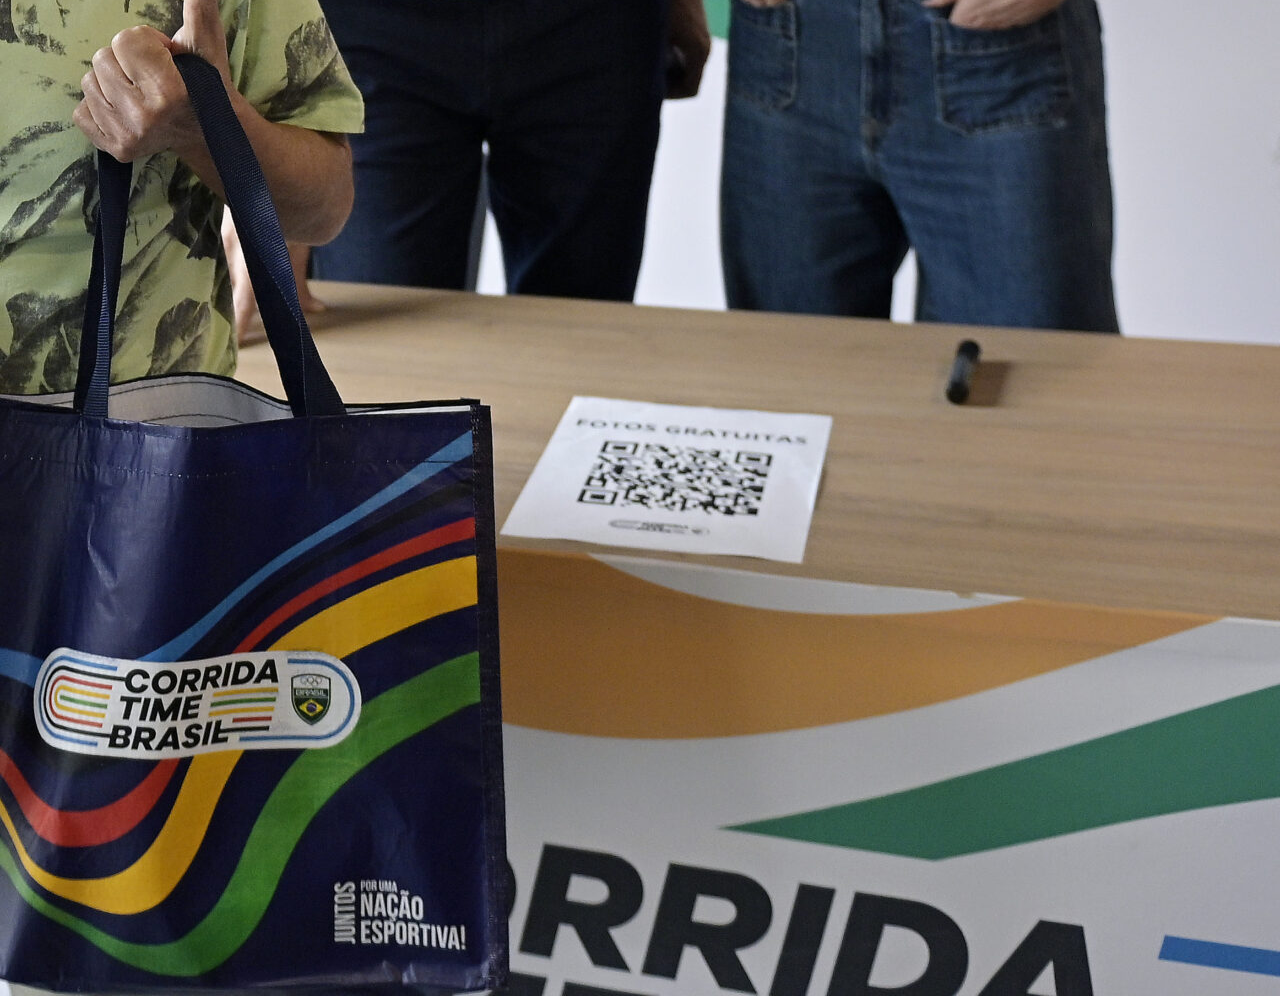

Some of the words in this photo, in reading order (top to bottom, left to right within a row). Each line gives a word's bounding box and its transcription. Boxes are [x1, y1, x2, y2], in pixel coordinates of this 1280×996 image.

[576, 418, 657, 433] FOTOS
[665, 424, 808, 445] GRATUITAS
[125, 659, 279, 695] CORRIDA
[120, 694, 204, 723] TIME
[108, 719, 229, 751] BRASIL
[360, 879, 378, 892] POR
[378, 879, 398, 893] UMA
[333, 881, 356, 945] JUNTOS
[360, 889, 424, 922] NAÇÃO
[506, 842, 1096, 996] RRIDA
[360, 919, 467, 951] ESPORTIVA!
